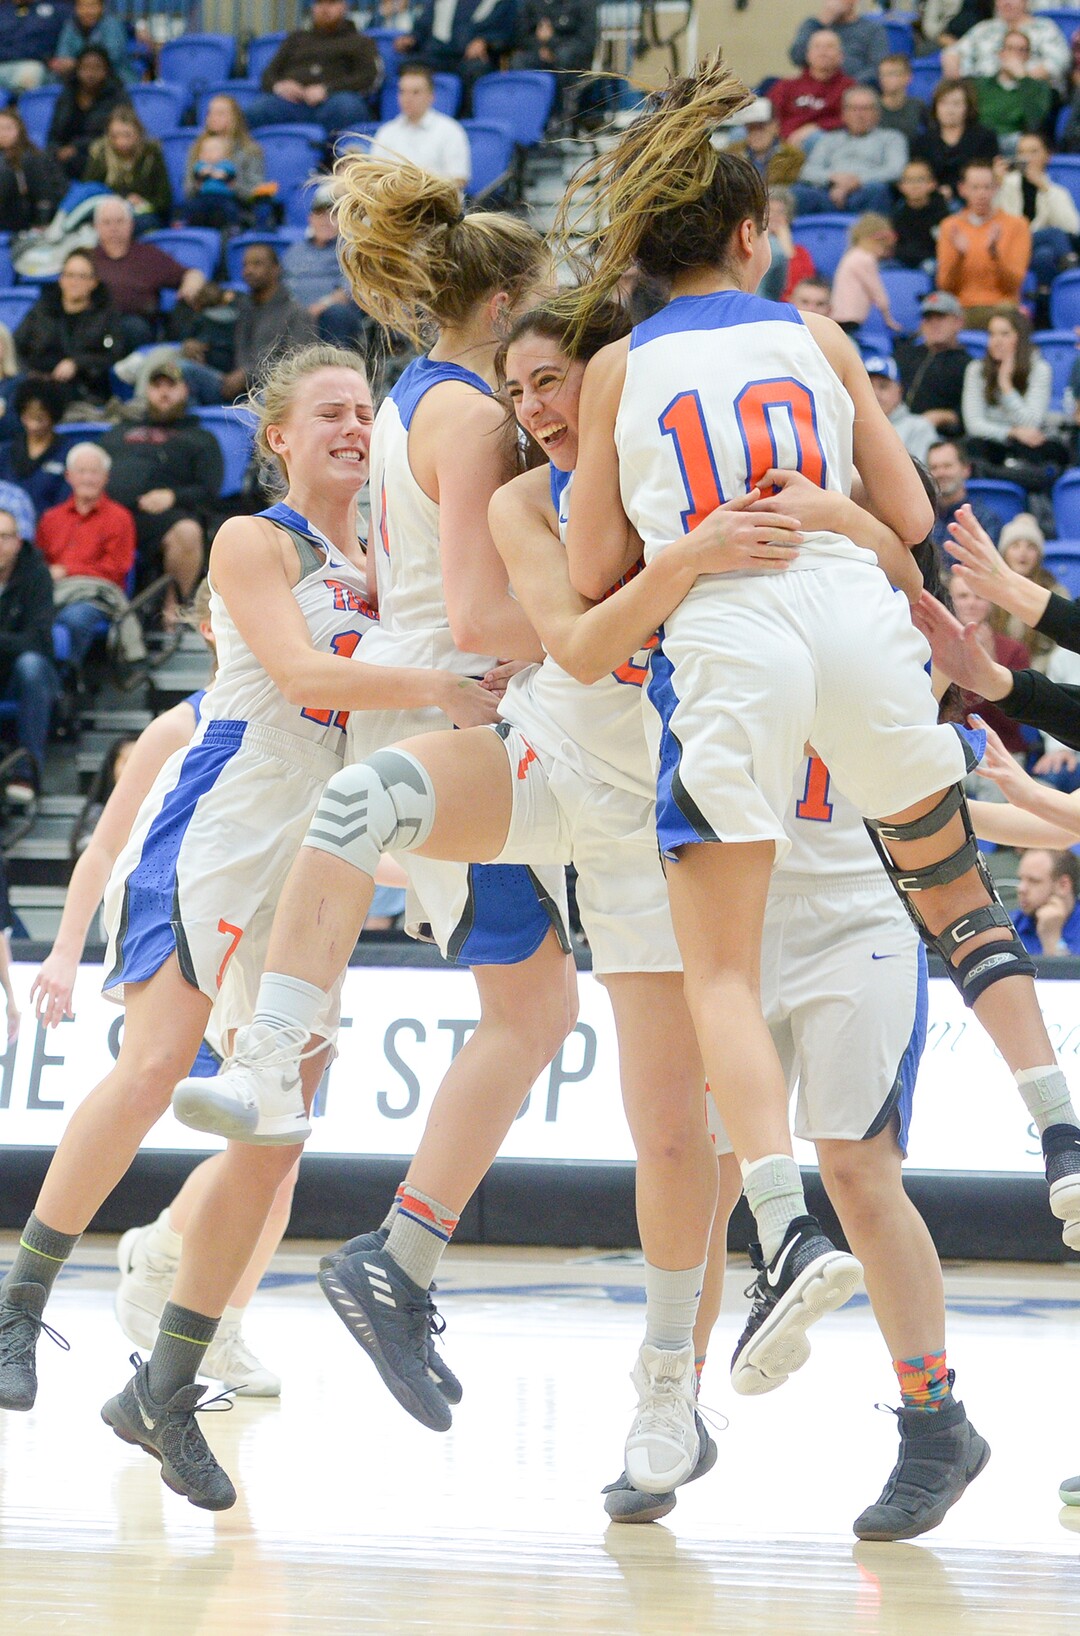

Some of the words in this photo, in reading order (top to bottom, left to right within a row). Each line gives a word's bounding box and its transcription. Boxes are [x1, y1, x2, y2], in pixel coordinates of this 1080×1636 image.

[657, 376, 827, 535] 10
[967, 952, 1011, 978] DONJOY
[376, 1018, 598, 1122] STP
